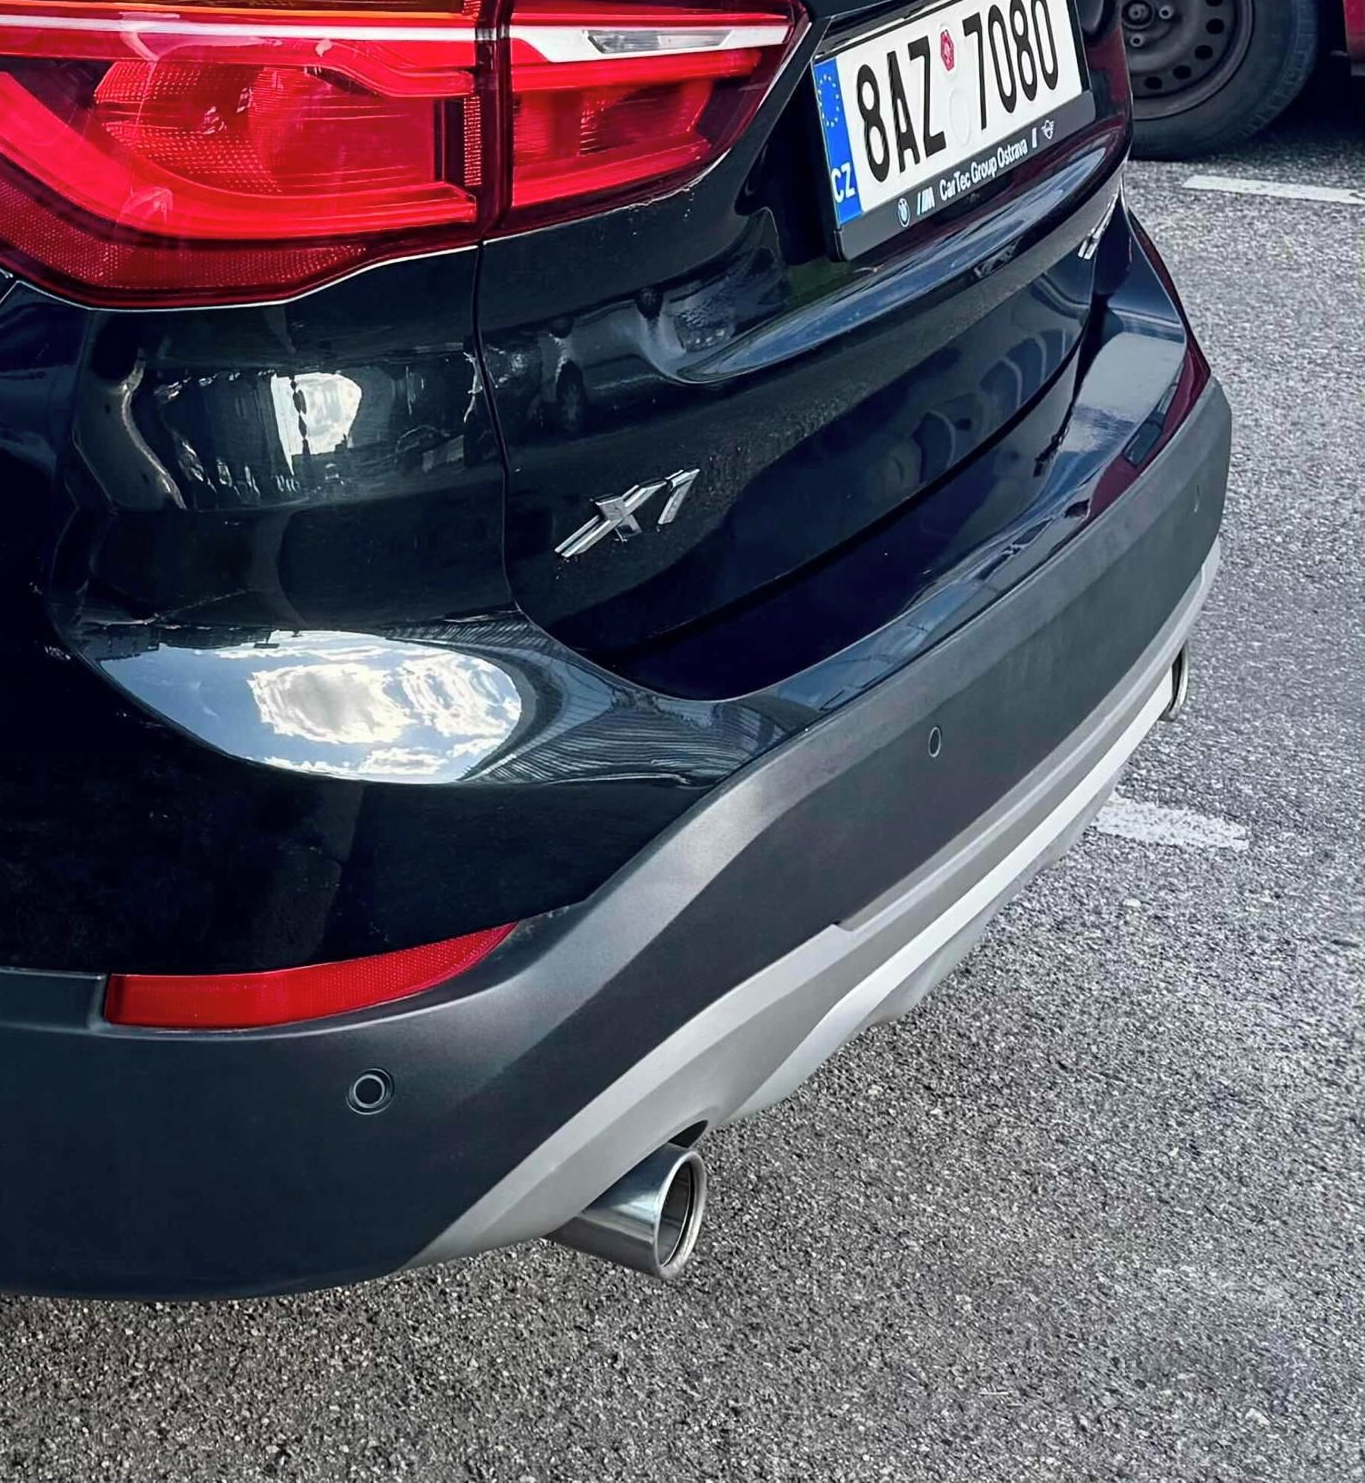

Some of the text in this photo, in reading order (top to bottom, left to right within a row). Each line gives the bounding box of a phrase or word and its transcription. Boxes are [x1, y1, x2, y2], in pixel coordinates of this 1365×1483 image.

[856, 35, 947, 183] 8AZ
[831, 162, 855, 204] CZ
[971, 156, 997, 183] Group
[554, 468, 701, 558] X1
